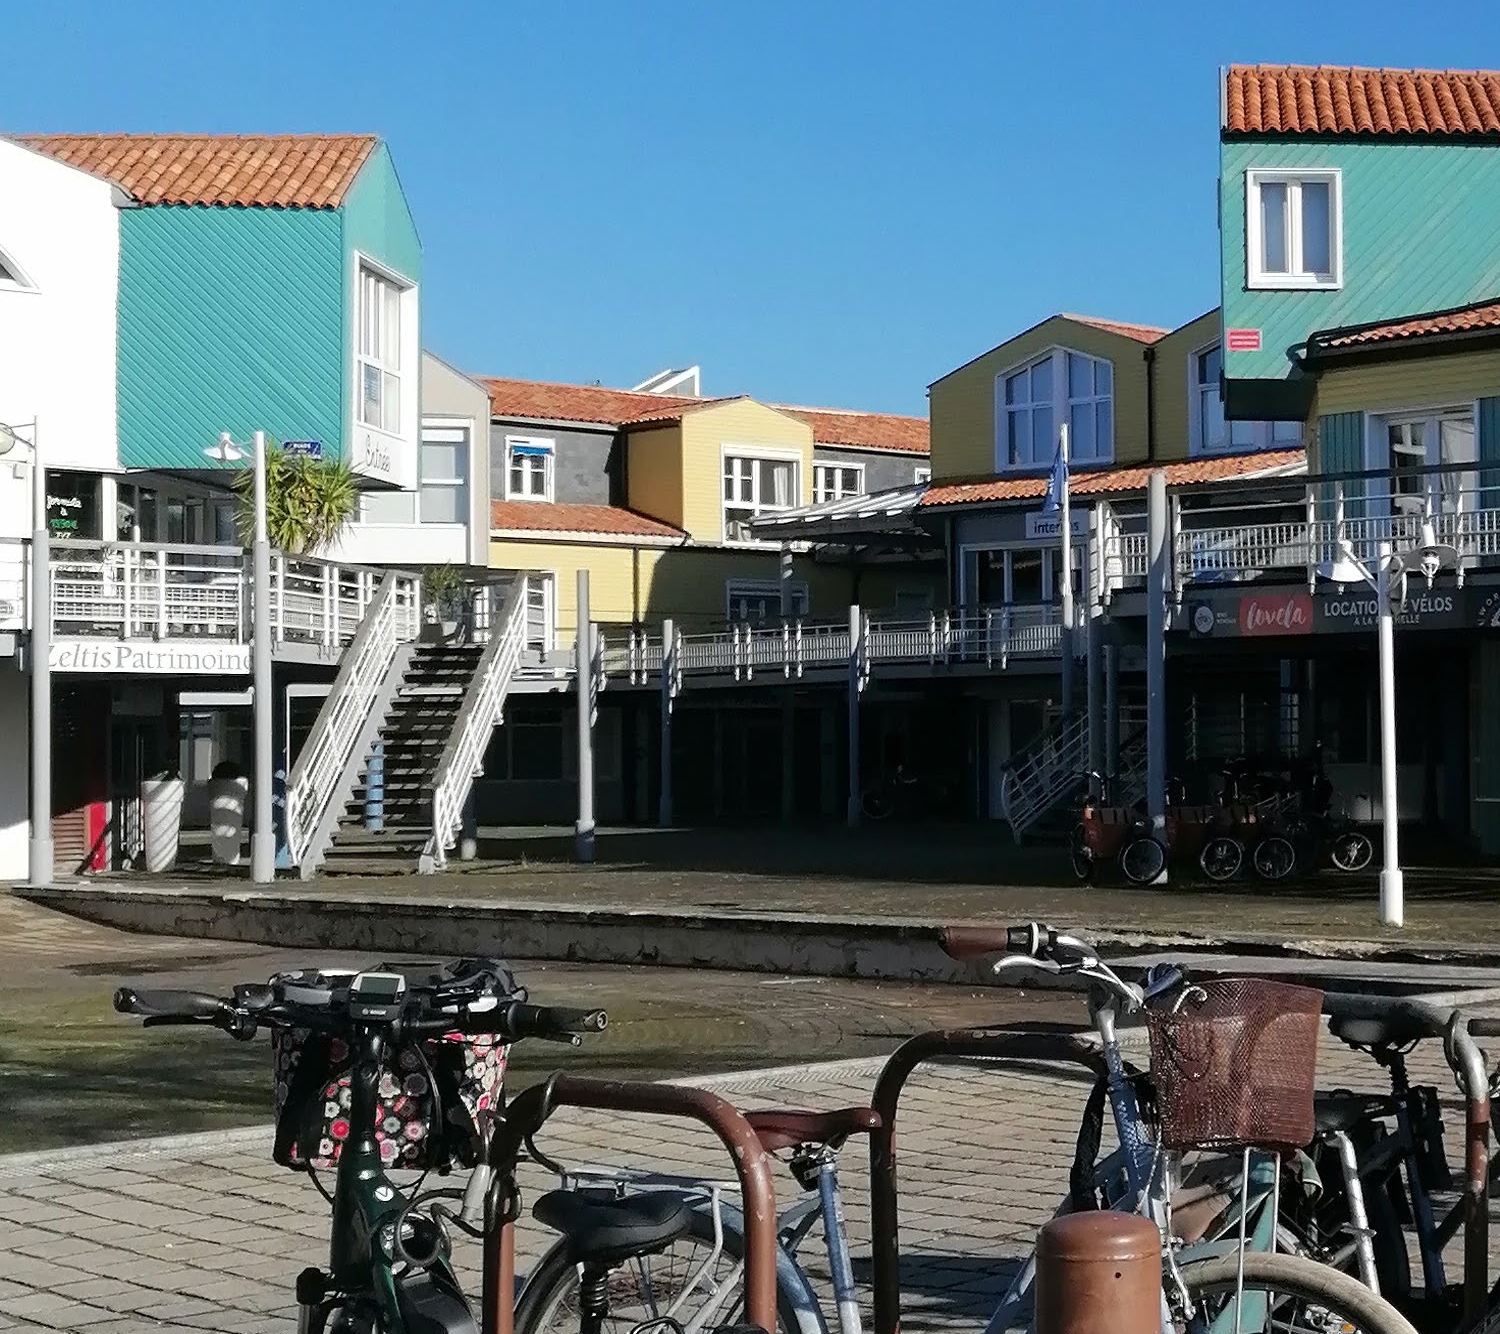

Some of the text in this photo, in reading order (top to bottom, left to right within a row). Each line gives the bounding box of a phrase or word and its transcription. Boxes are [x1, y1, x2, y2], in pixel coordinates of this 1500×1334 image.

[1246, 599, 1307, 630] lovela
[1324, 600, 1379, 617] LOCATIO
[1410, 593, 1453, 613] VÉLOS
